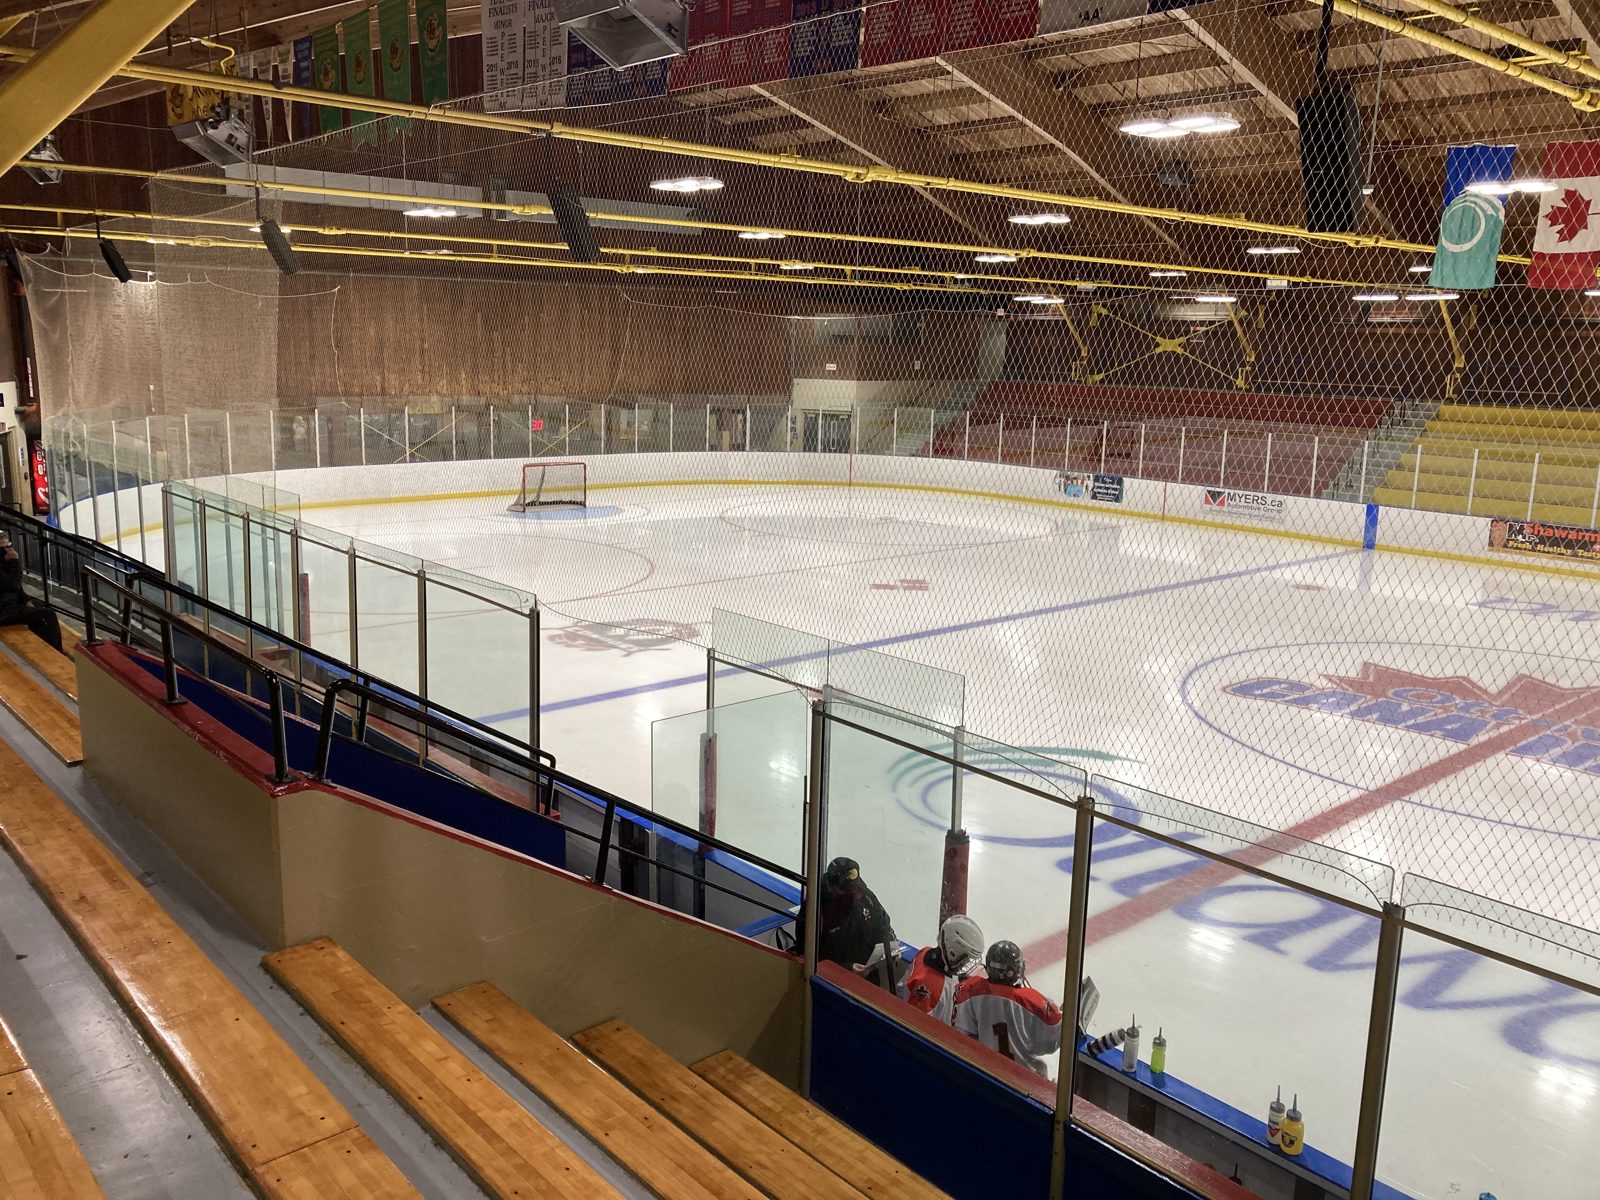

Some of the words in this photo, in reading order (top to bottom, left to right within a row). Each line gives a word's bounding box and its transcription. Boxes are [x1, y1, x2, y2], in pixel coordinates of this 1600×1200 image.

[488, 3, 518, 18] FINALISTS
[493, 19, 513, 29] MINOR
[506, 60, 519, 70] 2016
[1226, 491, 1283, 508] MYERS.ca
